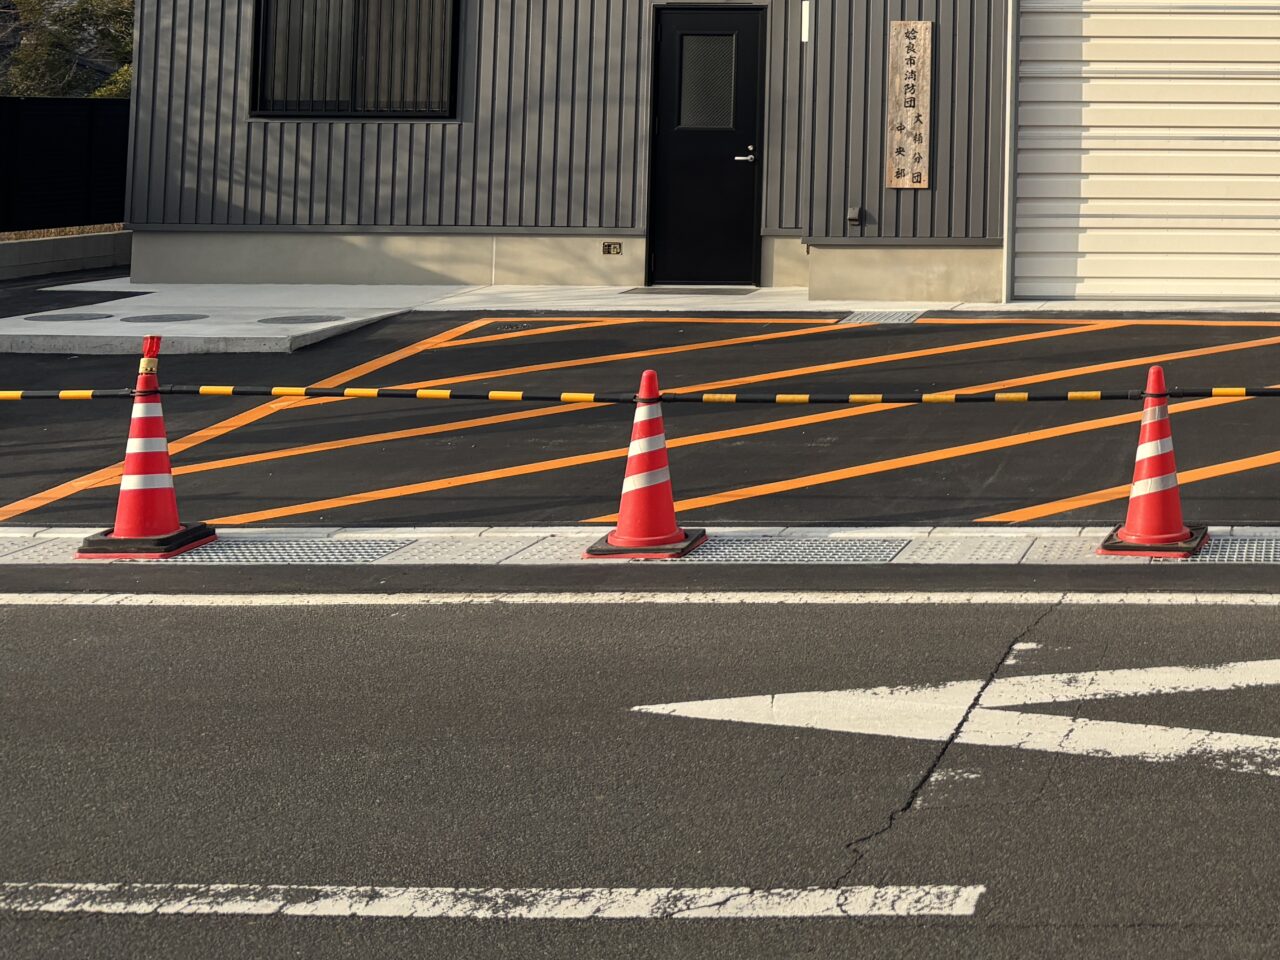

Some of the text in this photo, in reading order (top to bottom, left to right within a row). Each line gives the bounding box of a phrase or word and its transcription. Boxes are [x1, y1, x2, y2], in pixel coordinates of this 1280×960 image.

[904, 28, 919, 109] 姶良市消防団
[894, 122, 907, 179] 中央部
[912, 112, 924, 184] 大楠分団
